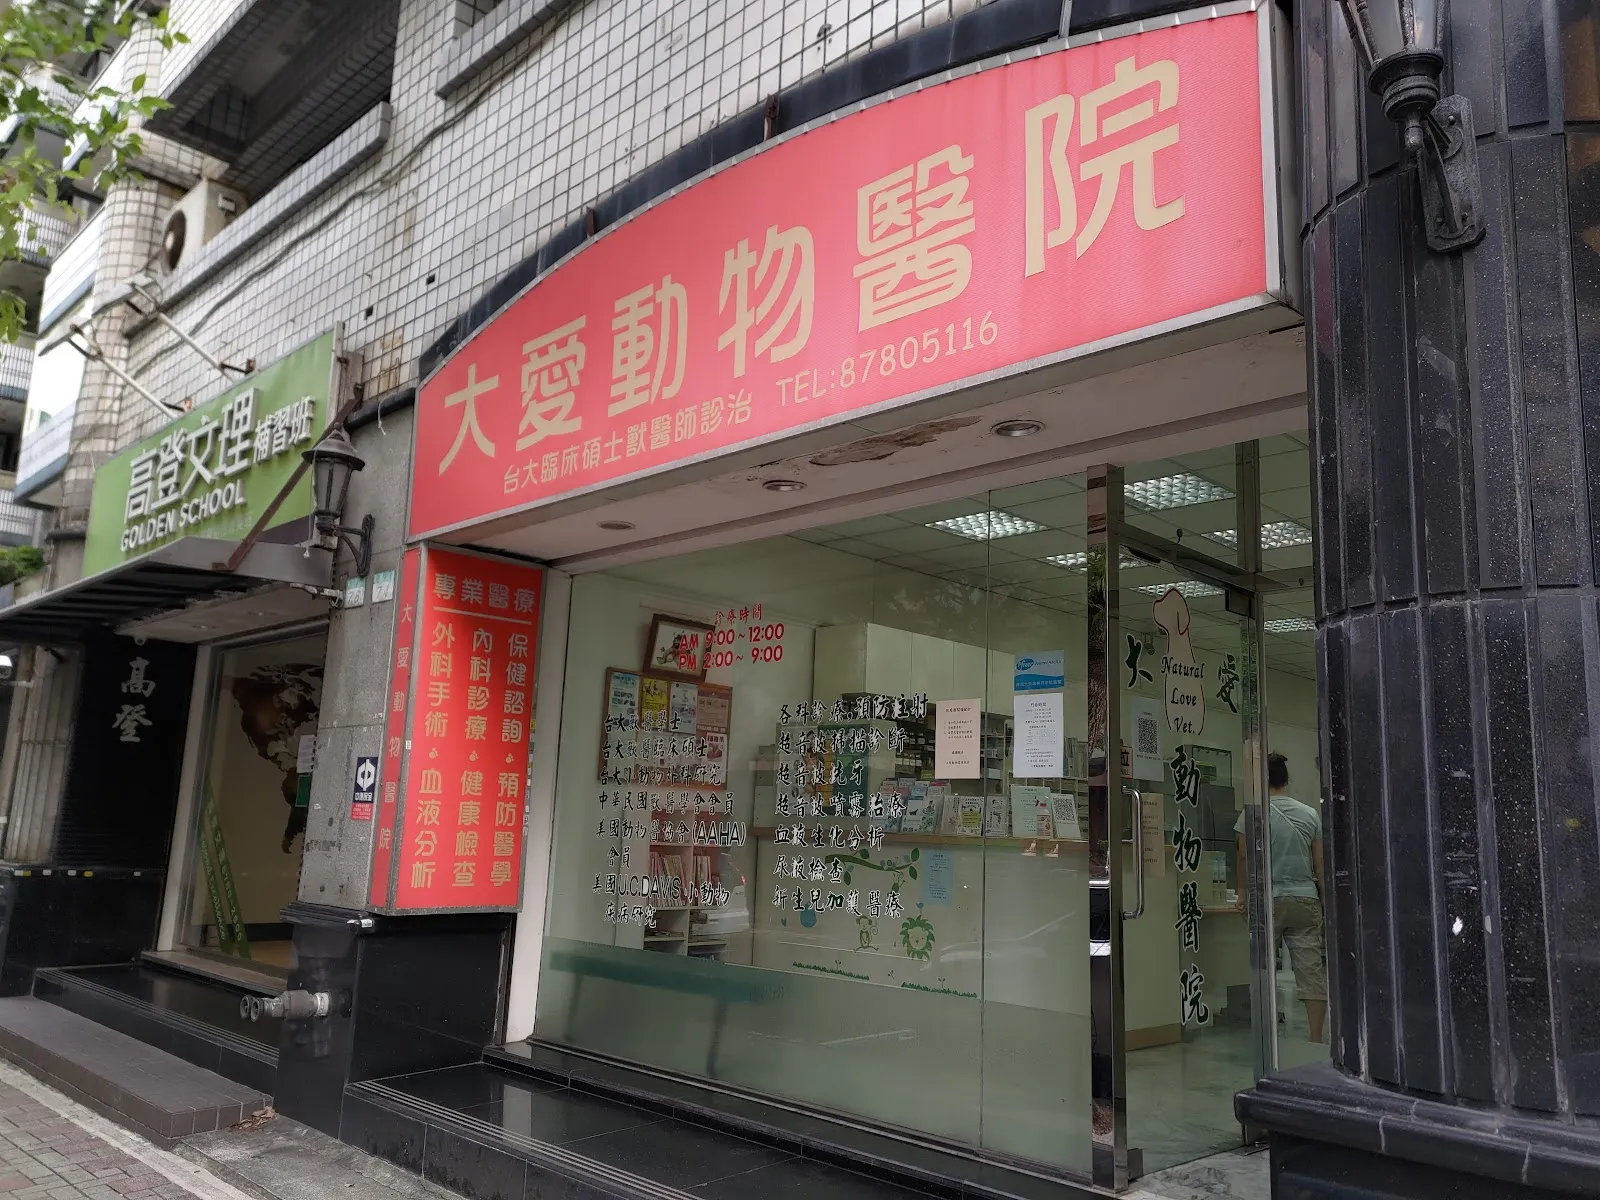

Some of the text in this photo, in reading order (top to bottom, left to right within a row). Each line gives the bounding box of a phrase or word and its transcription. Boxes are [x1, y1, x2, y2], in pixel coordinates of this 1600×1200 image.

[438, 55, 1185, 476] 大愛動物醫院
[503, 388, 753, 496] 台大臨床碩士獸醫師診治
[120, 510, 176, 552] GOLDEN
[178, 478, 246, 533] SCHOOL
[433, 572, 535, 614] 專業醫療
[714, 603, 763, 626] 診療時間
[679, 633, 699, 651] AM
[677, 654, 697, 672] PM
[1160, 655, 1204, 680] Natural
[112, 656, 156, 743] 高登
[1170, 687, 1198, 707] Love
[378, 602, 414, 851] 大愛動物醫院
[1172, 715, 1196, 735] Vet.
[410, 621, 456, 889] 外科手術 血液分析
[489, 632, 529, 888] 保健諮詢 預防醫學
[775, 758, 866, 787] 超音波洗牙
[451, 769, 484, 888] 健康檢查
[773, 822, 886, 852] 血液生化分析
[607, 844, 632, 870] 會員
[773, 854, 844, 884] 尿液檢查
[1170, 744, 1210, 1026] 動物醫院
